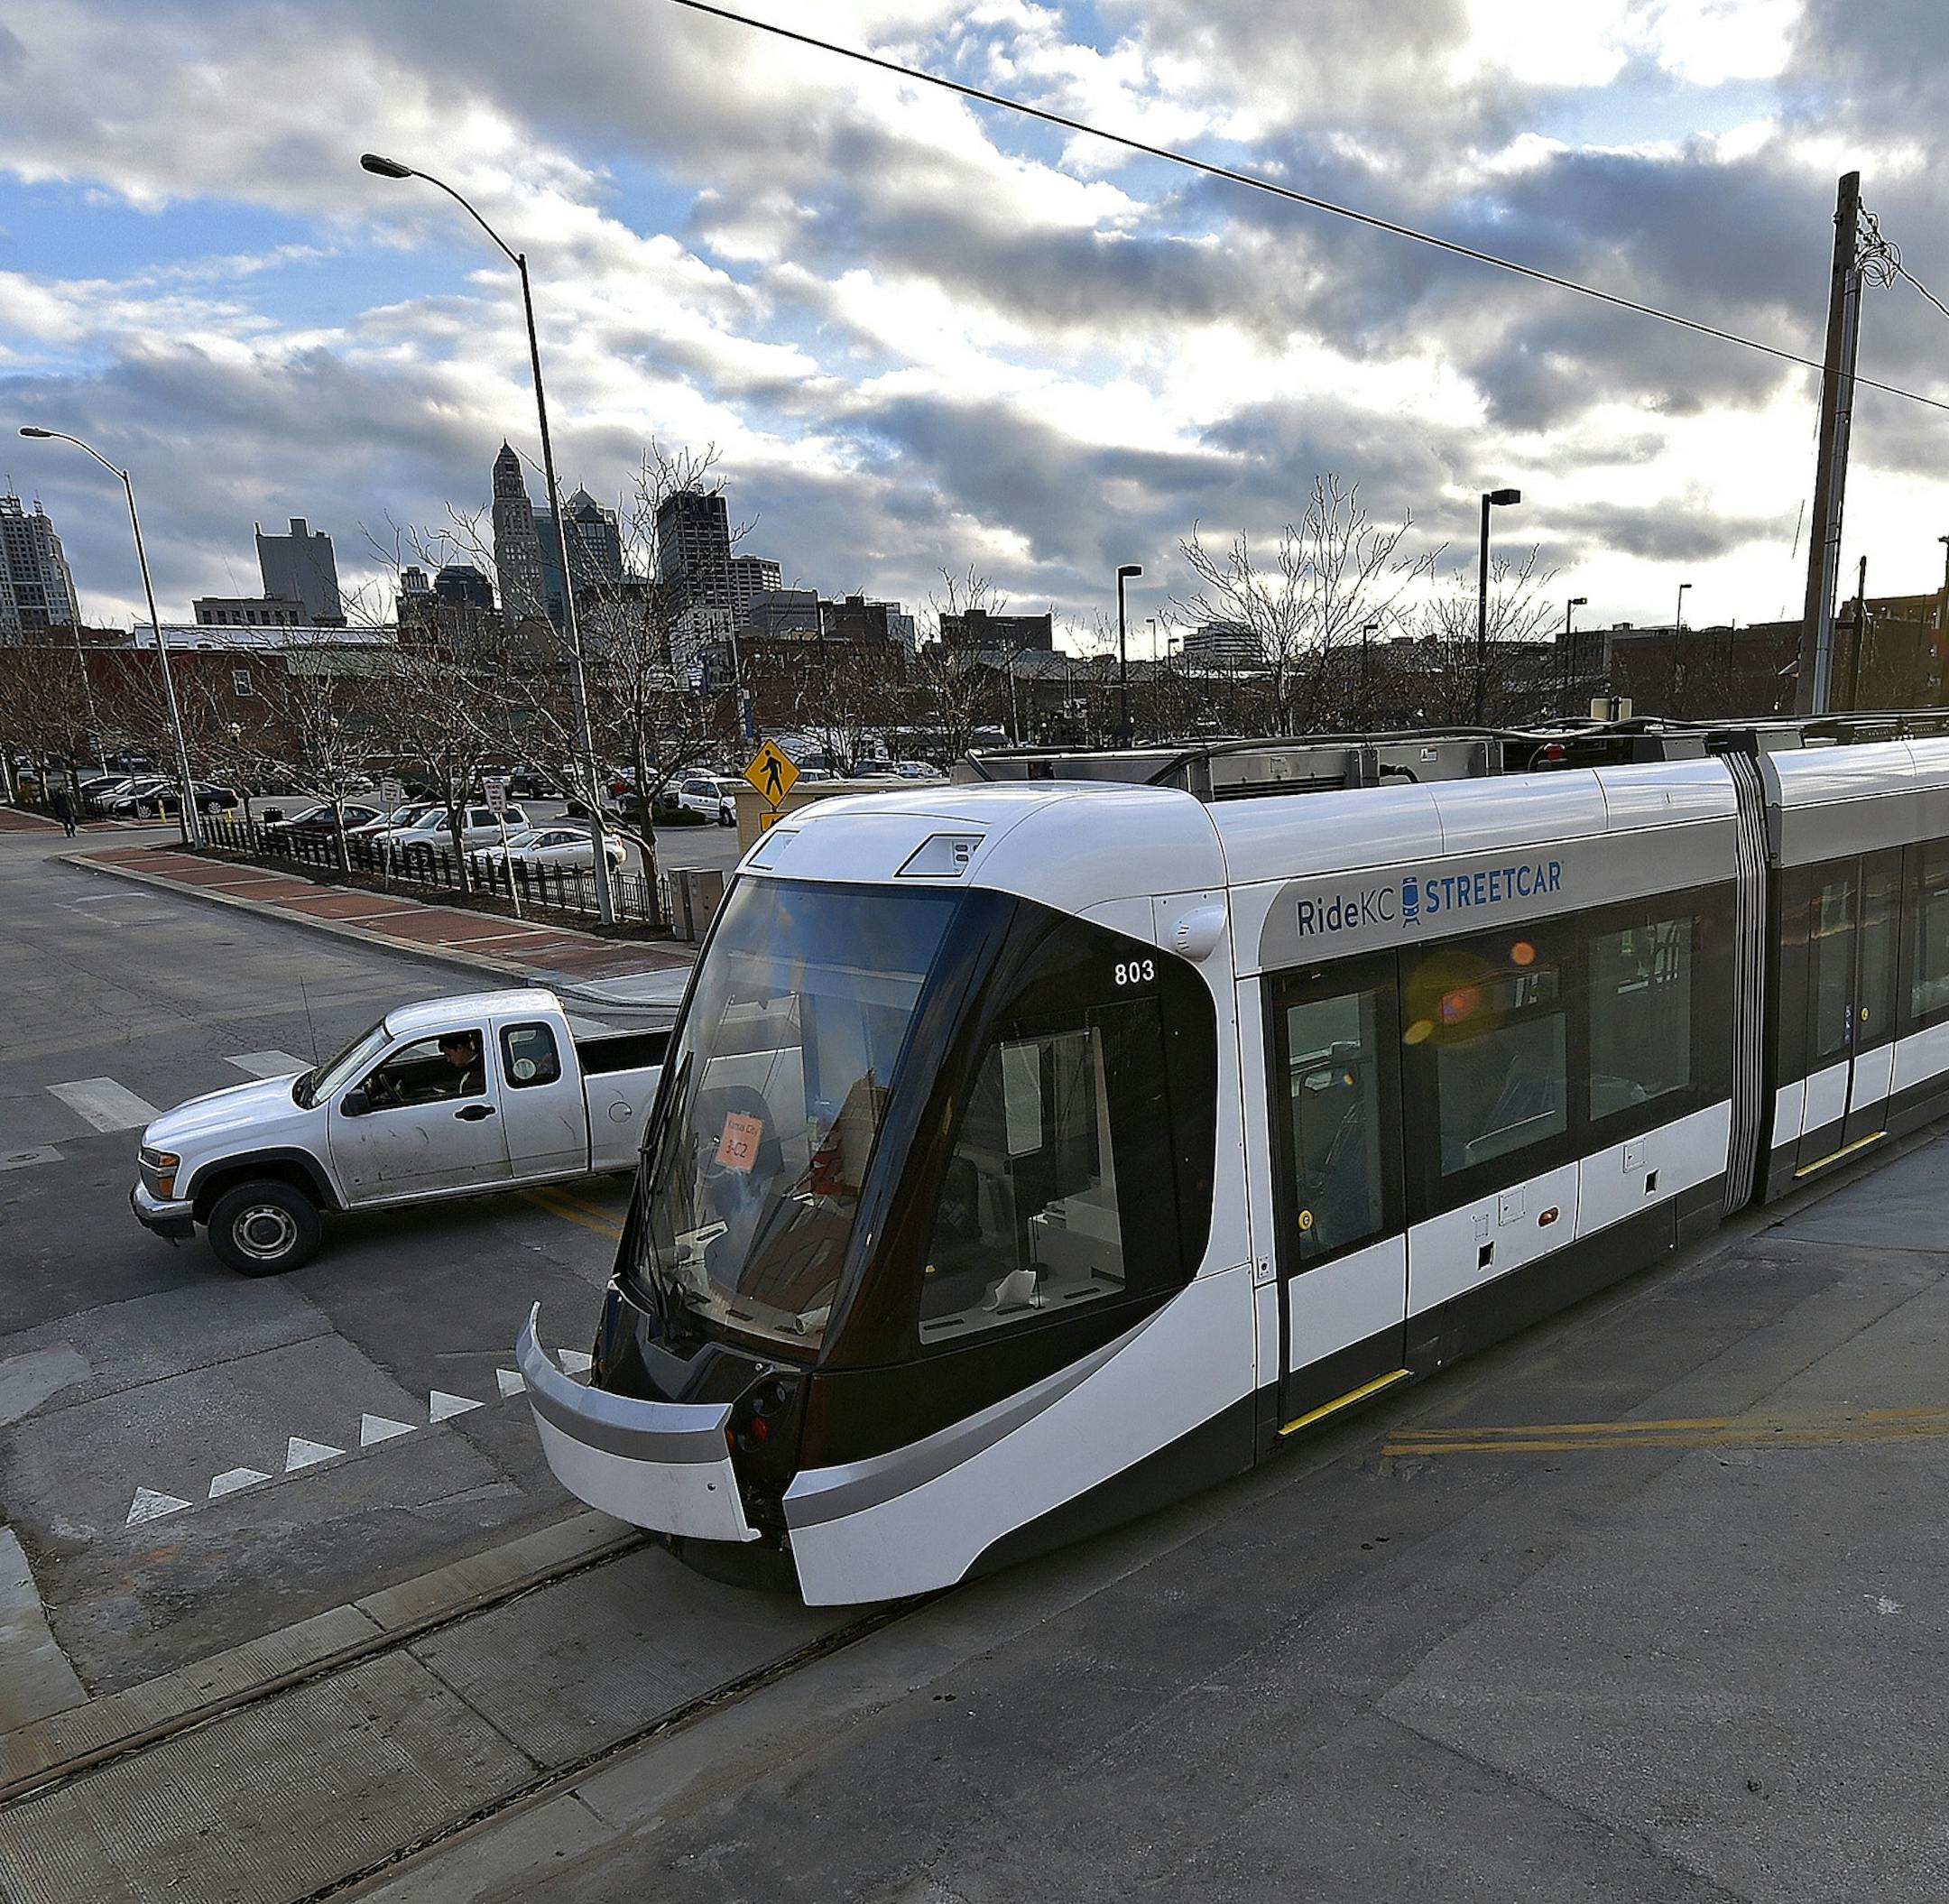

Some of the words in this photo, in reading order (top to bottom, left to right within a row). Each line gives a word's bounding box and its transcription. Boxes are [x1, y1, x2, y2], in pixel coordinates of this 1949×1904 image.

[1297, 888, 1395, 937] RideKC
[1425, 861, 1561, 914] STREETCAR
[1114, 959, 1154, 985] 803
